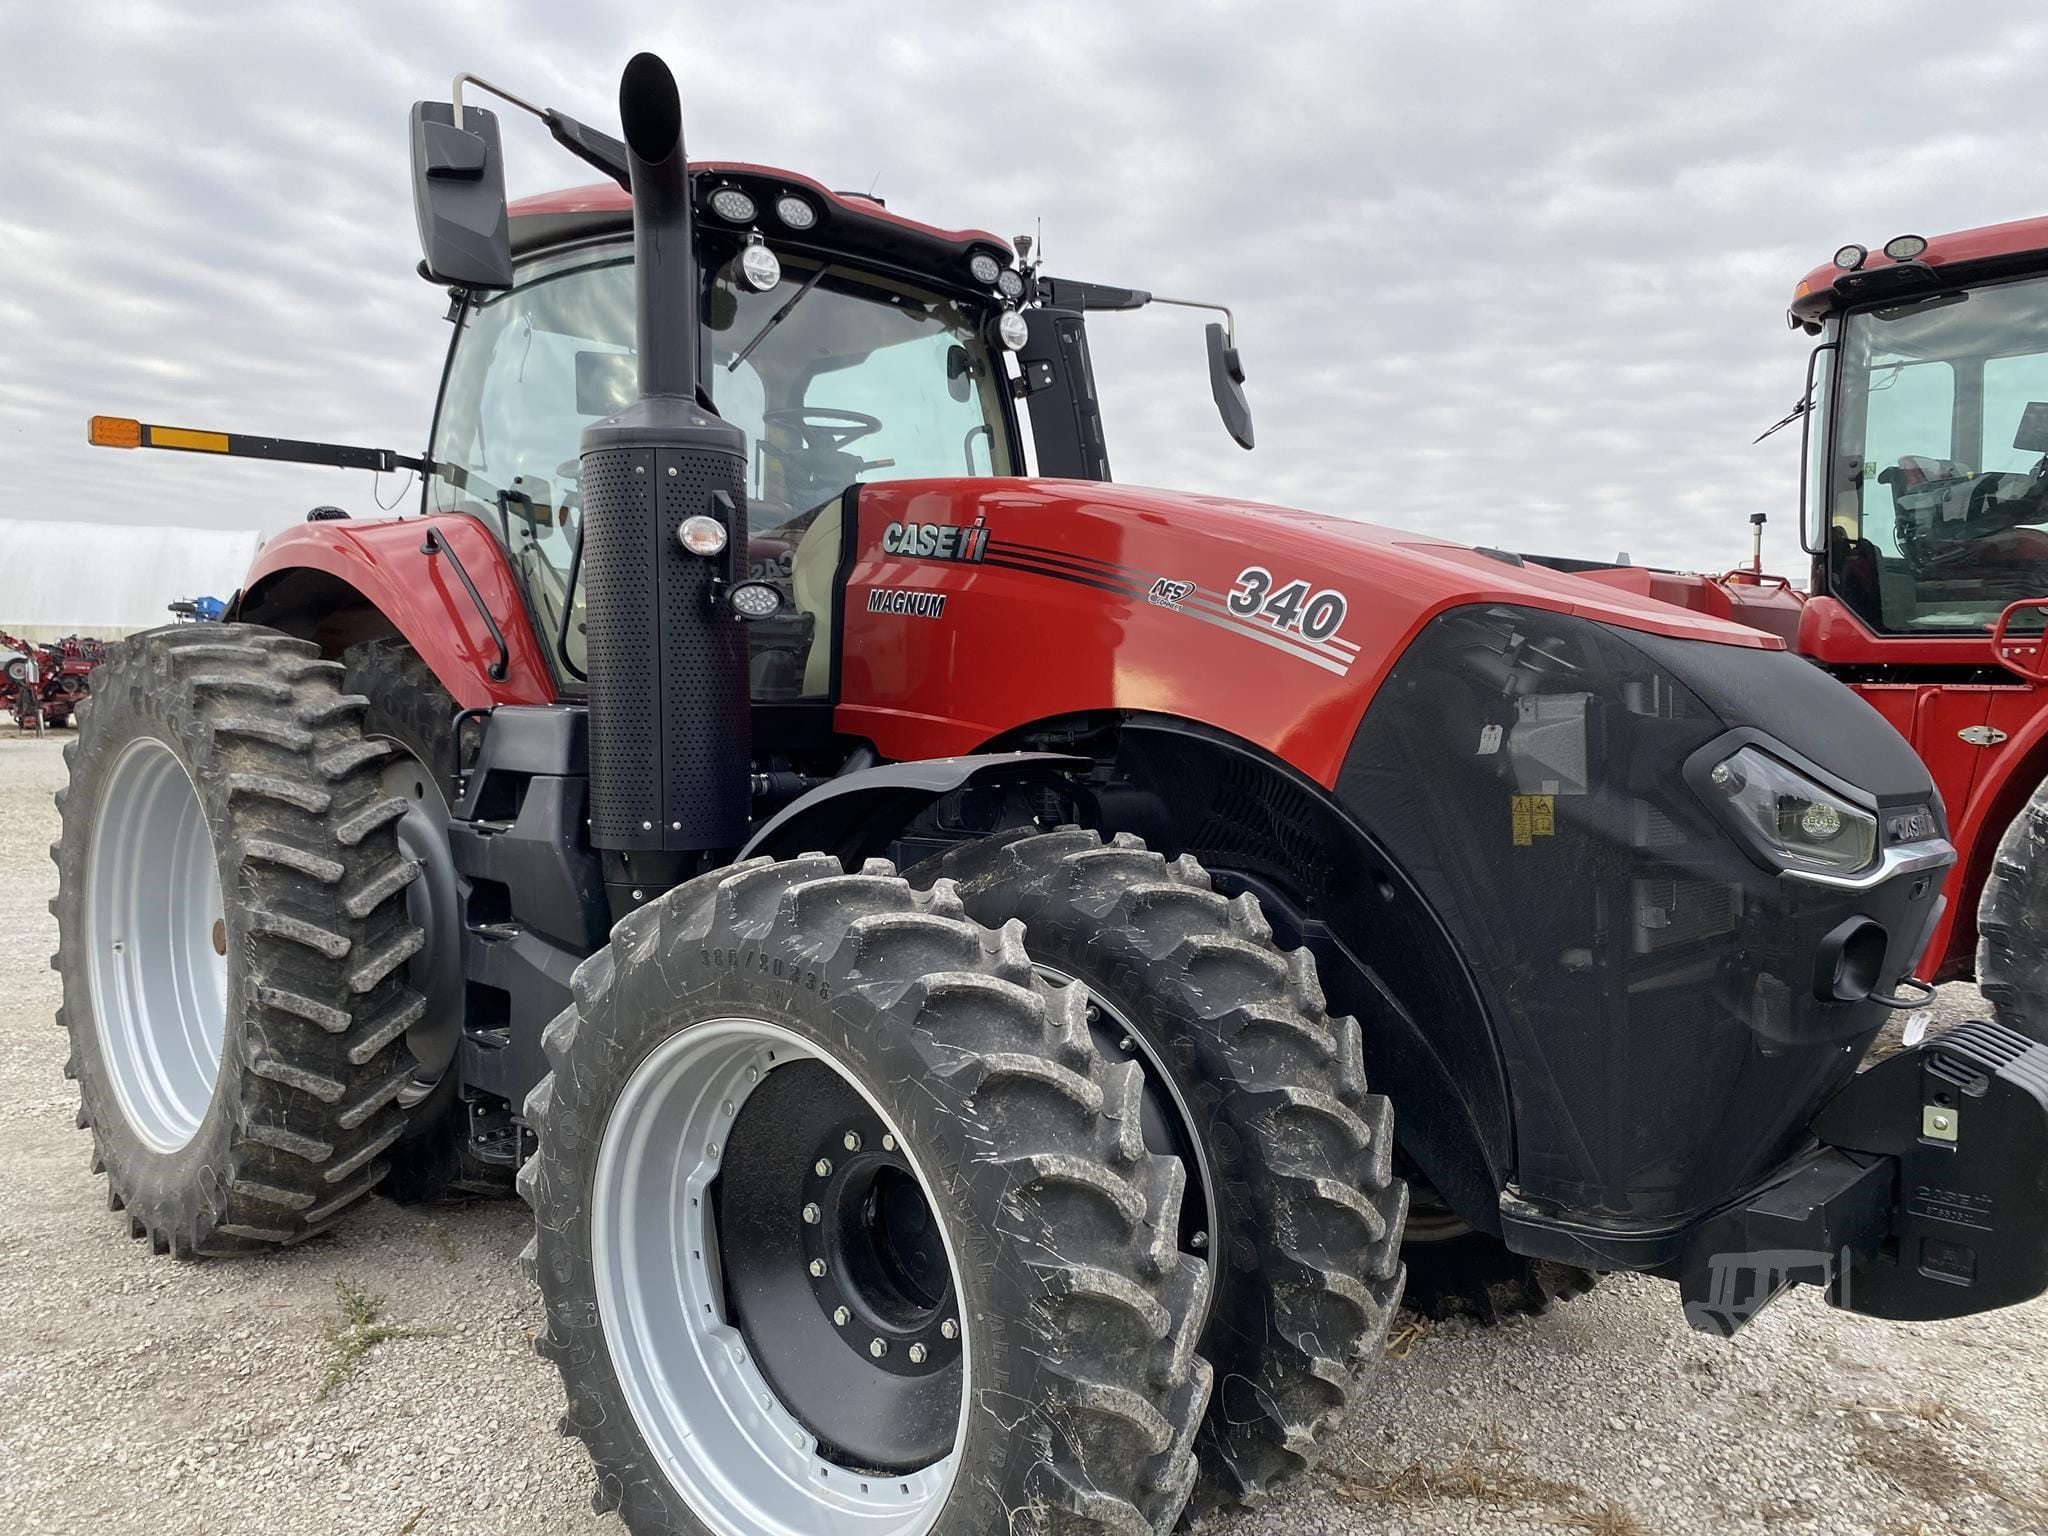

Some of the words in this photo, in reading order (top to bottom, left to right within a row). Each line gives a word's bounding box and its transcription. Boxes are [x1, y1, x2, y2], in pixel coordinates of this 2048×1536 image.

[867, 588, 947, 619] MAGNUM
[1149, 577, 1187, 601] AFS
[1227, 565, 1348, 643] 340
